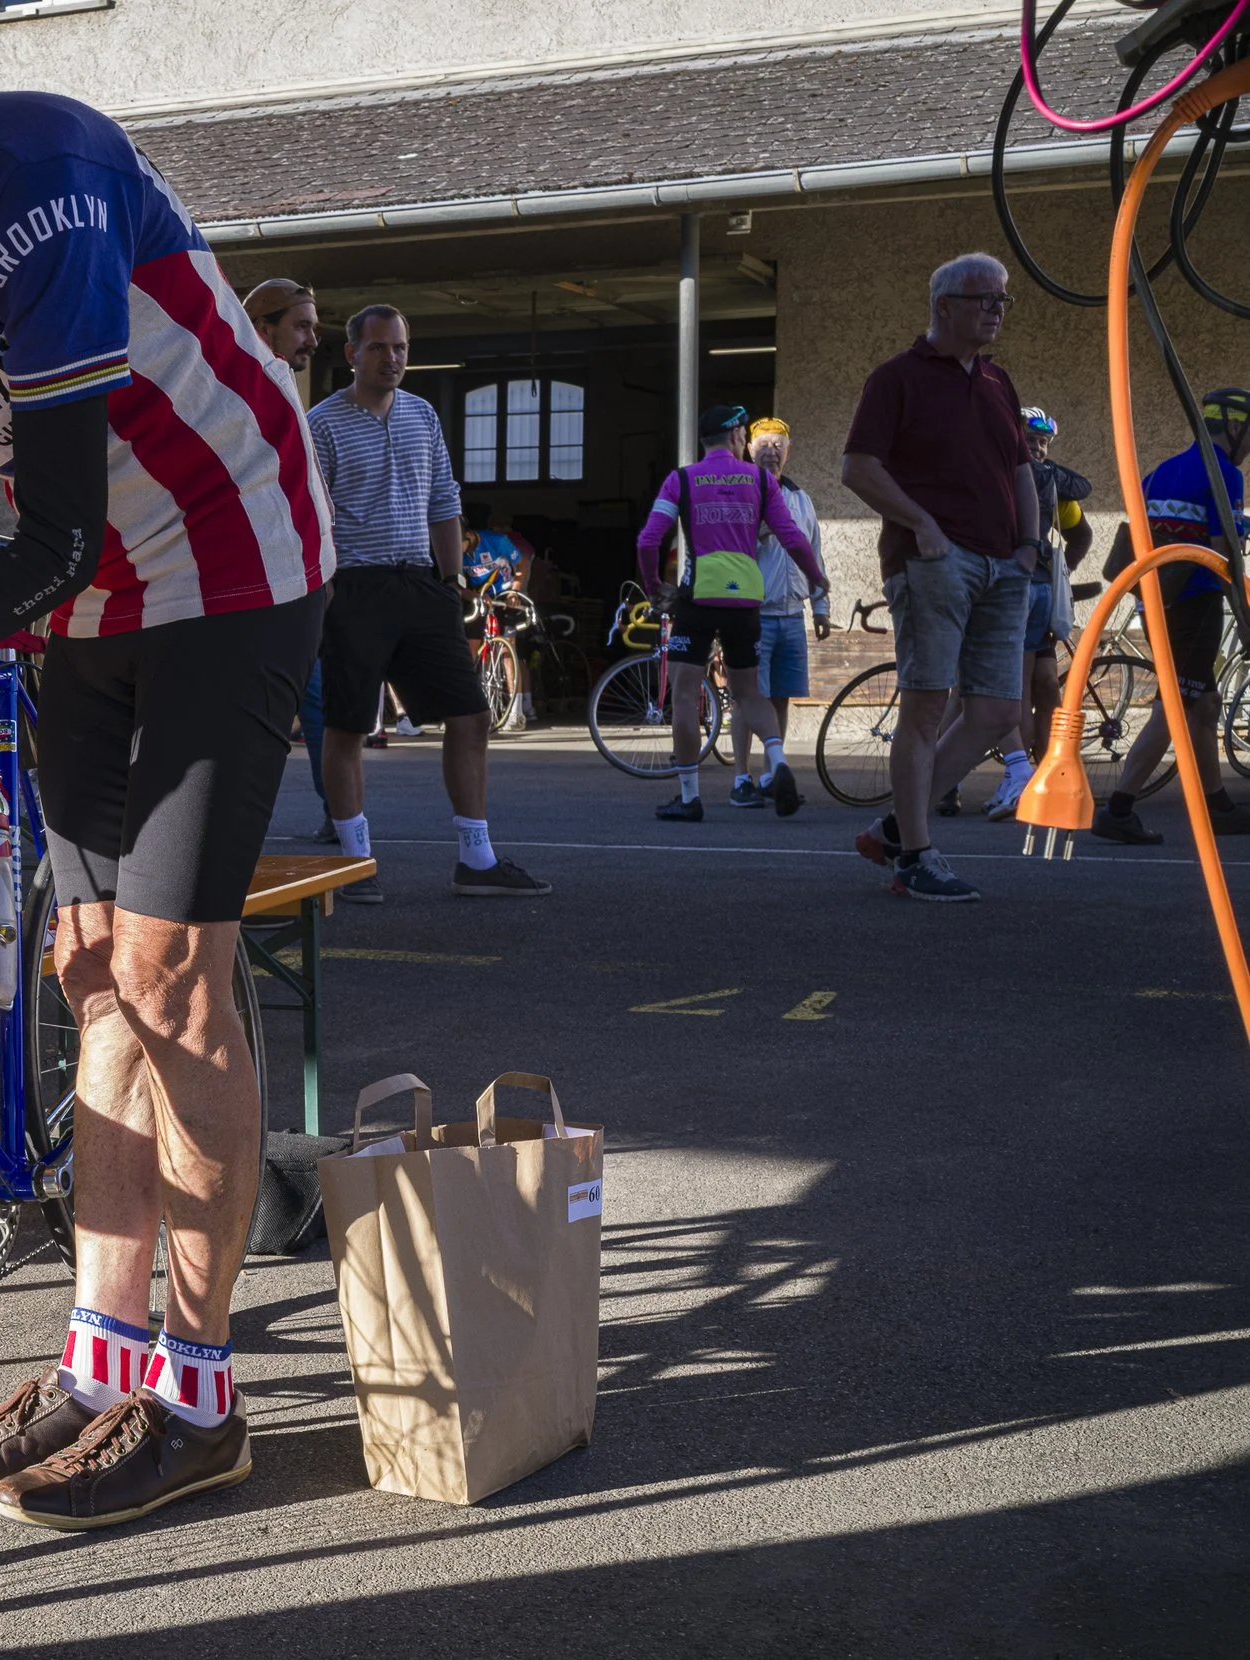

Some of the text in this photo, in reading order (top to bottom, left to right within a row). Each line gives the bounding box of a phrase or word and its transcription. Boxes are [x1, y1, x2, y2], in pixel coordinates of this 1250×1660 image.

[694, 474, 755, 487] PALAZZO
[588, 1185, 601, 1203] 60
[72, 1310, 102, 1326] LYN
[158, 1333, 223, 1360] OOKLYN
